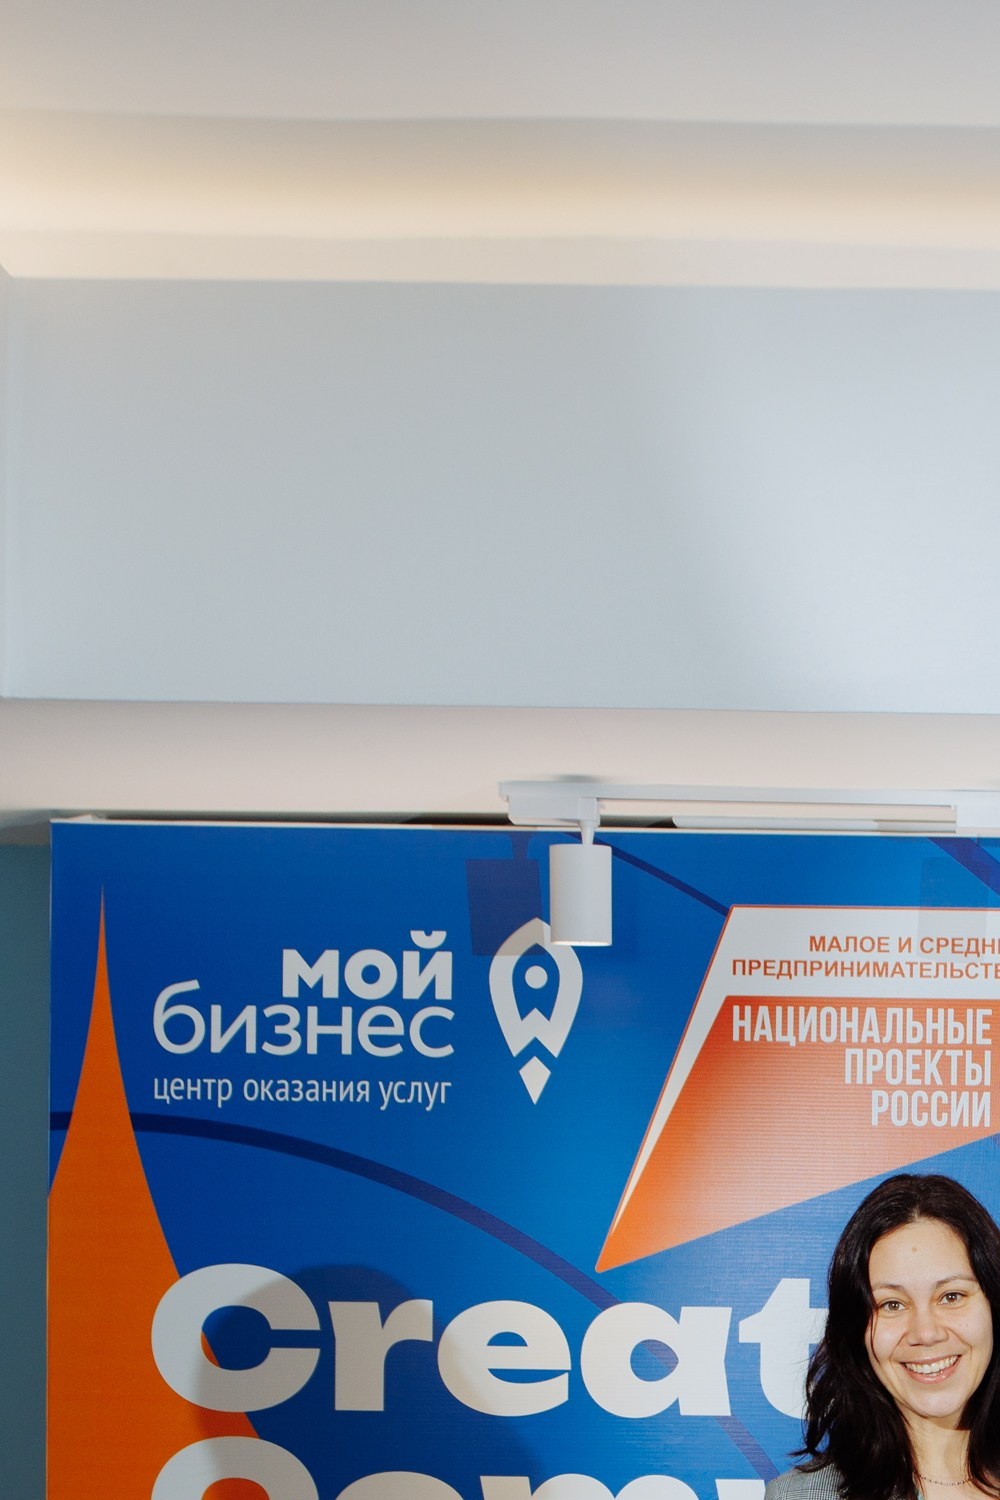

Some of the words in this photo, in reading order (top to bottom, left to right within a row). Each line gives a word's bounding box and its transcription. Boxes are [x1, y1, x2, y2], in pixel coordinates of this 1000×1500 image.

[809, 935, 890, 953] МАЛОЕ
[898, 937, 913, 953] И
[282, 930, 452, 1000] мой
[153, 979, 455, 1058] бизнес
[732, 1005, 992, 1046] НАЦИОНАЛЬНЫЕ
[844, 1048, 991, 1086] ПРОЕКТЫ
[153, 1078, 233, 1107] центр
[243, 1079, 370, 1102] оказания
[381, 1080, 452, 1110] услуг
[871, 1090, 991, 1127] РОССИИ
